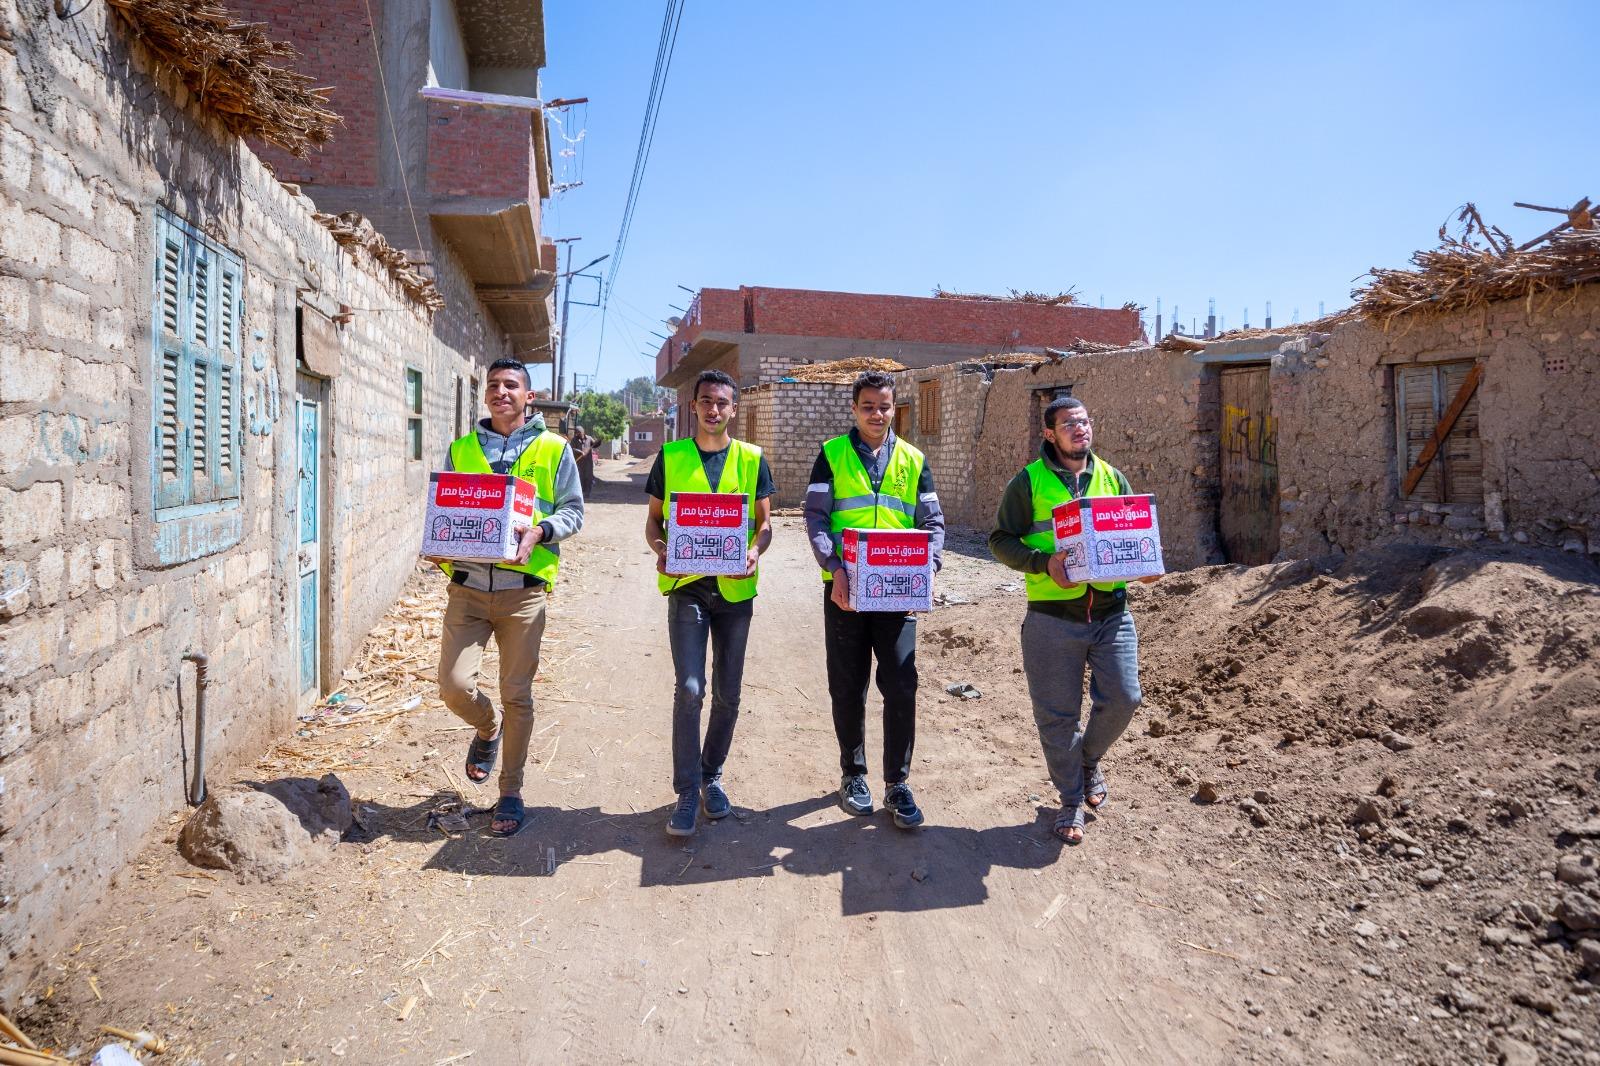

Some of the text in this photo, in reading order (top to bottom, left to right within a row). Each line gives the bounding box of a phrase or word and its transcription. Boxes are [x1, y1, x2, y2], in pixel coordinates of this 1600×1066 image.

[440, 486, 502, 499] صندوق تحيا مصر
[680, 506, 739, 518] صندوق تحيا مصر
[1096, 507, 1149, 522] صندوق تحيا مصر
[451, 529, 481, 541] الخير
[694, 547, 721, 559] الخير
[870, 547, 886, 556] مصر
[886, 545, 900, 556] تحيا
[900, 545, 925, 556] صندوق
[1114, 550, 1140, 564] الخير
[884, 586, 910, 597] الخير
